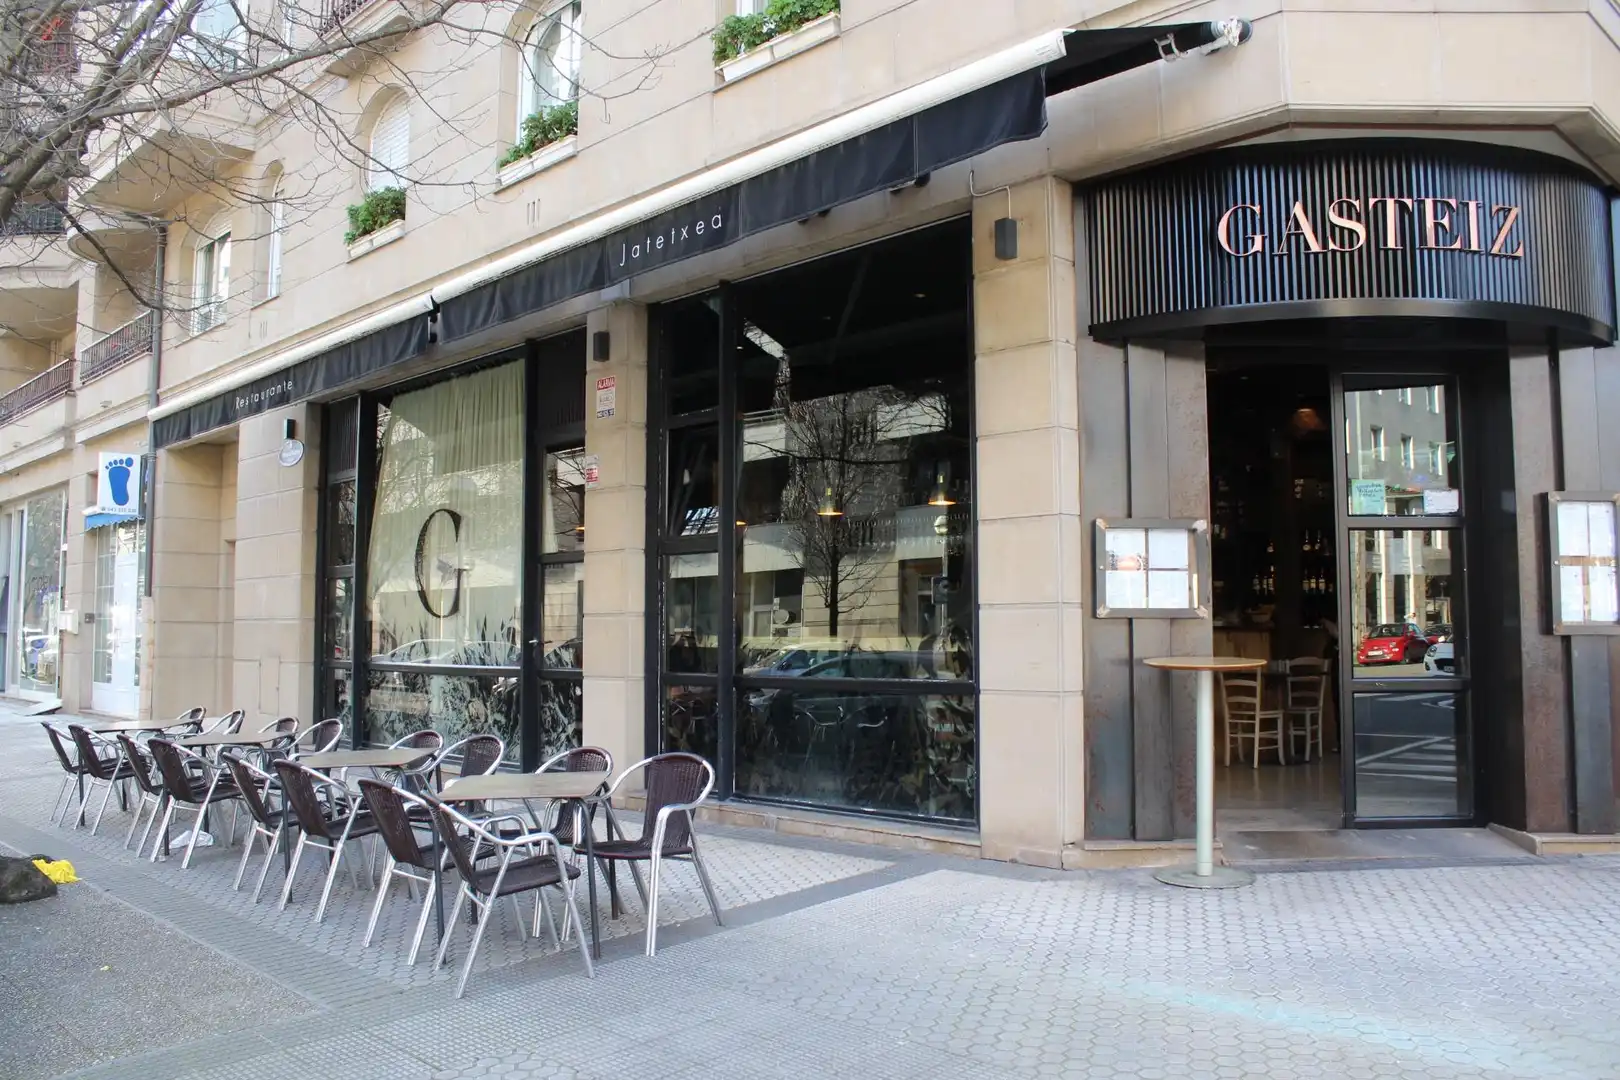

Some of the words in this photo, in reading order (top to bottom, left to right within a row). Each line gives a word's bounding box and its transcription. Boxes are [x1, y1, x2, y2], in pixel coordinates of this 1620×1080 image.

[619, 213, 722, 267] Jatetxea
[1217, 197, 1525, 258] GASTEIZ
[235, 380, 293, 410] Restaurante
[414, 508, 472, 619] G
